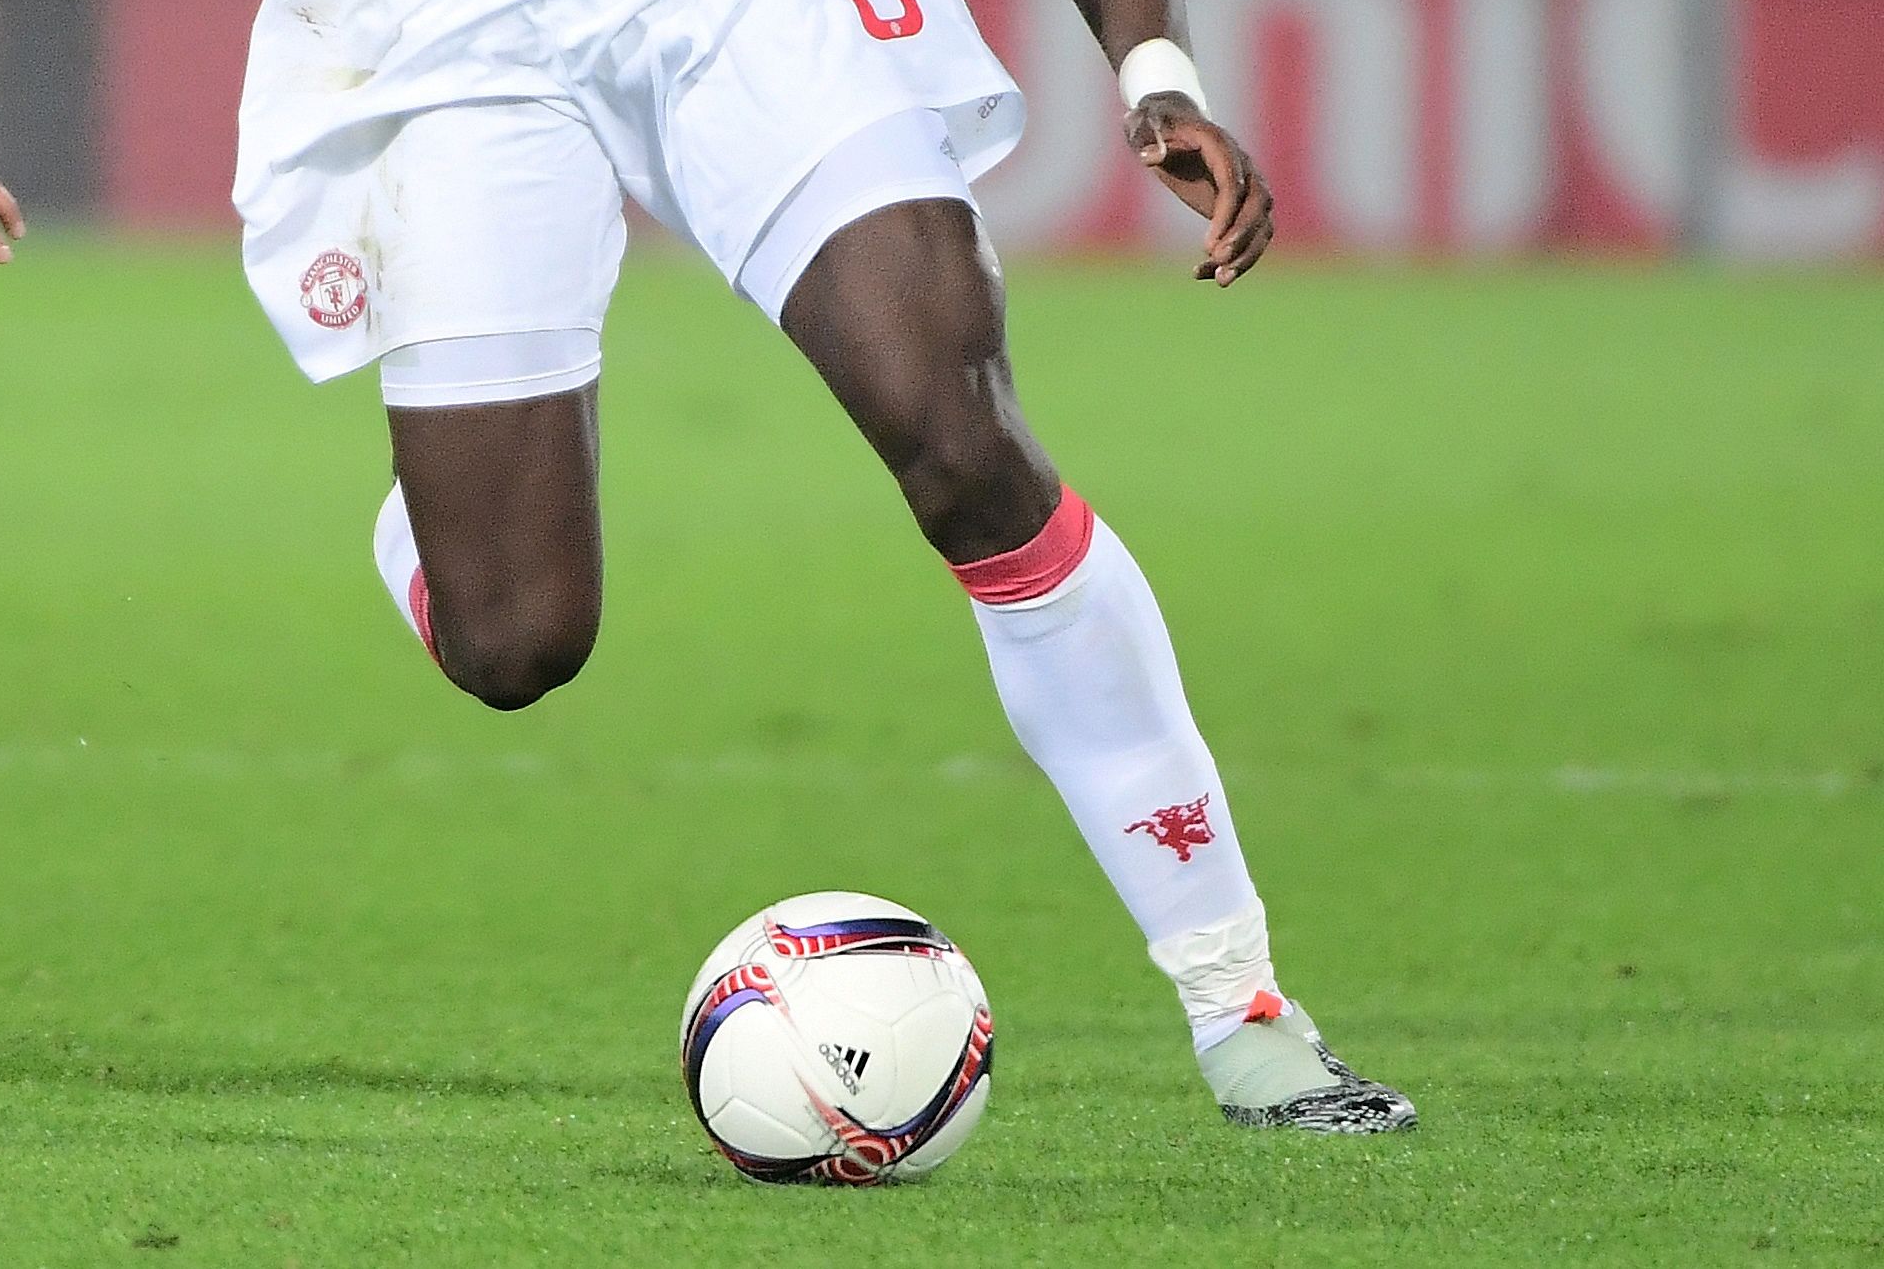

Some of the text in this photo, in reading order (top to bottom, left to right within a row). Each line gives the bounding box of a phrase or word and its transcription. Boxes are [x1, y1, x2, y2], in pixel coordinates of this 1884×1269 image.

[303, 253, 360, 286] MANCHESTER
[320, 304, 360, 325] UNITED
[818, 1043, 860, 1096] adidas
